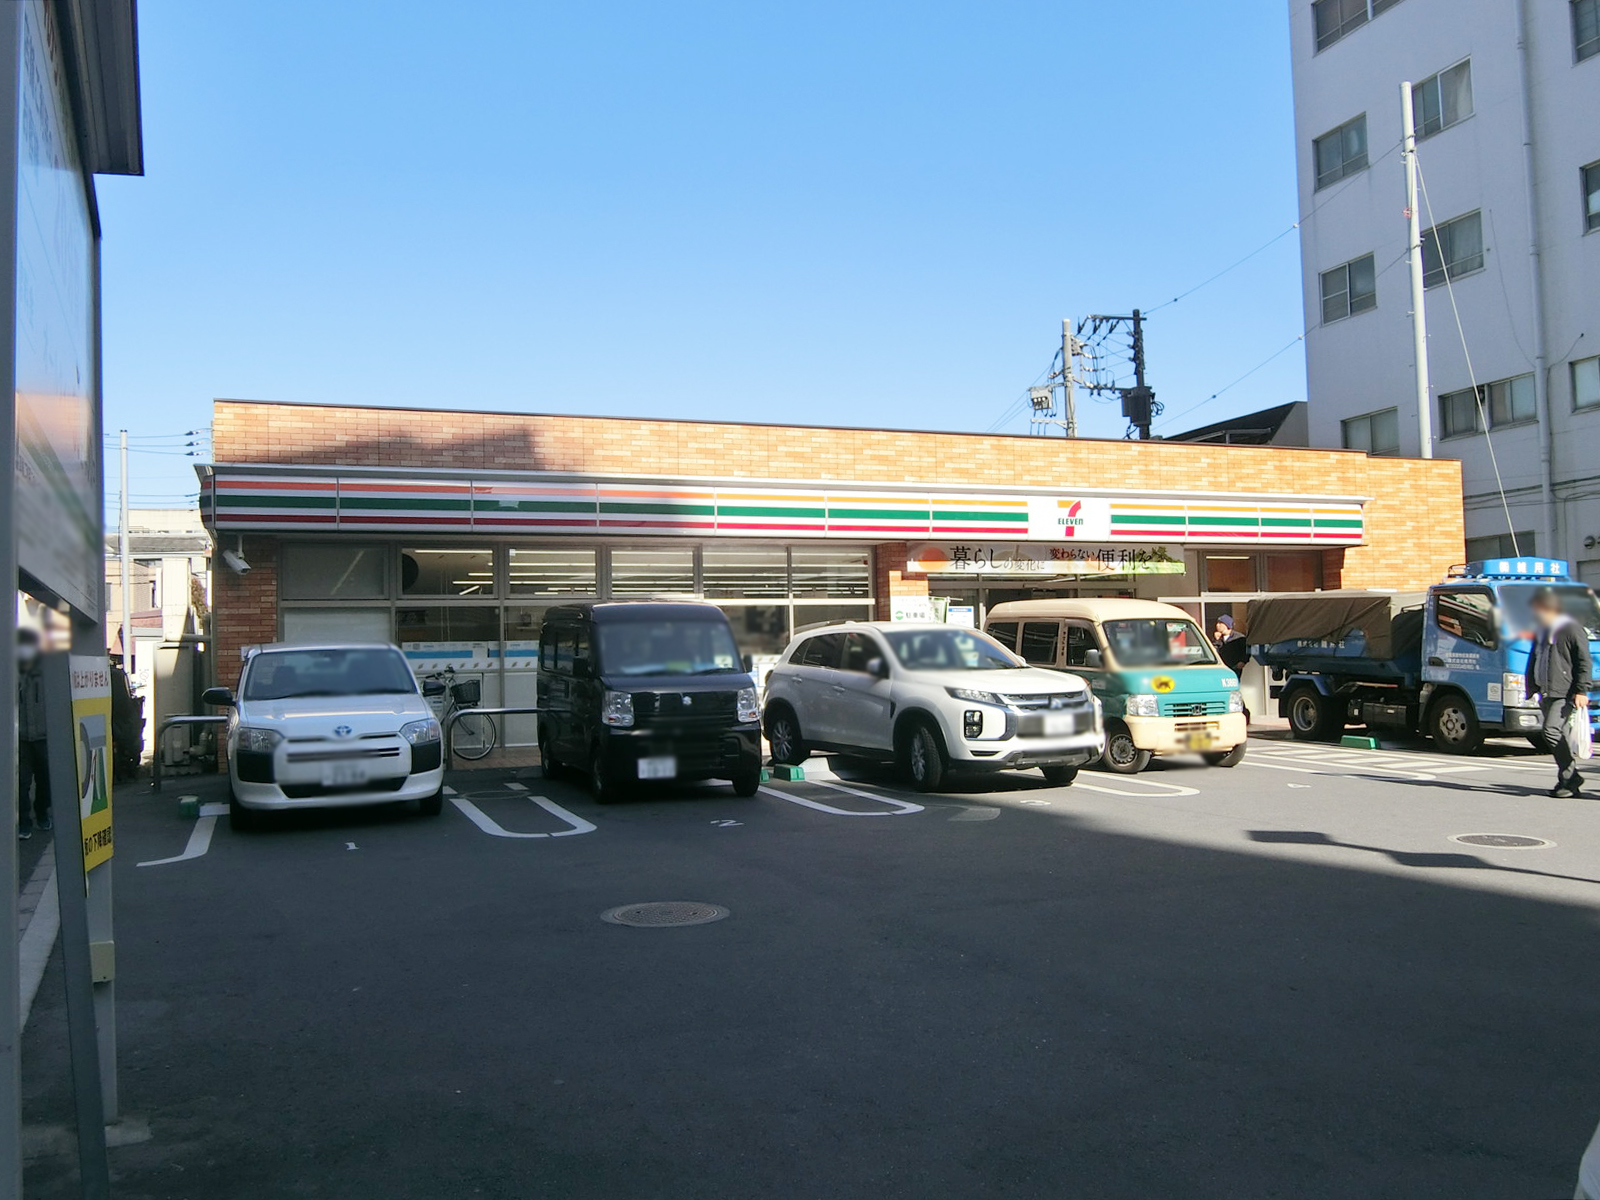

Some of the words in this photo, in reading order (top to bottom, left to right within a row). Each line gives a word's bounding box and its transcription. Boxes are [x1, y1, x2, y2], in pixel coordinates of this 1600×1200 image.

[1057, 500, 1082, 537] 7
[949, 546, 1045, 571] 暮らしの変化に
